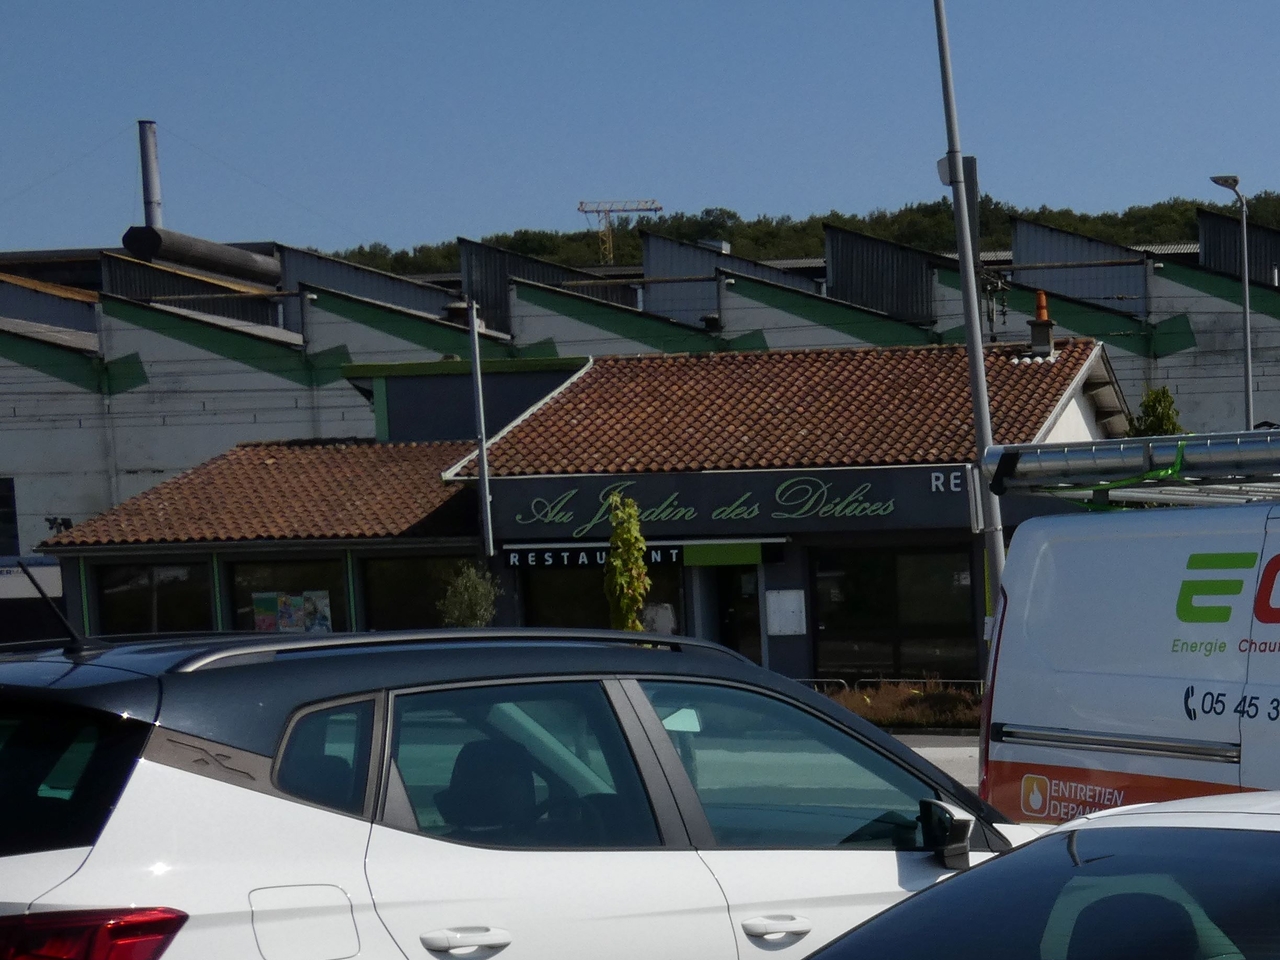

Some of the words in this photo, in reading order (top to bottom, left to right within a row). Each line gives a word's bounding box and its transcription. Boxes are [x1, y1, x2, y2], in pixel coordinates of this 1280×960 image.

[515, 488, 579, 524] Au
[572, 480, 698, 538] Jdin
[711, 491, 760, 519] des
[771, 476, 896, 519] Délices
[509, 549, 679, 566] RESTAUNT
[1170, 638, 1227, 657] Energie
[1201, 691, 1227, 716] 05
[1233, 695, 1260, 719] 45
[1051, 779, 1124, 806] ENTRETIEN
